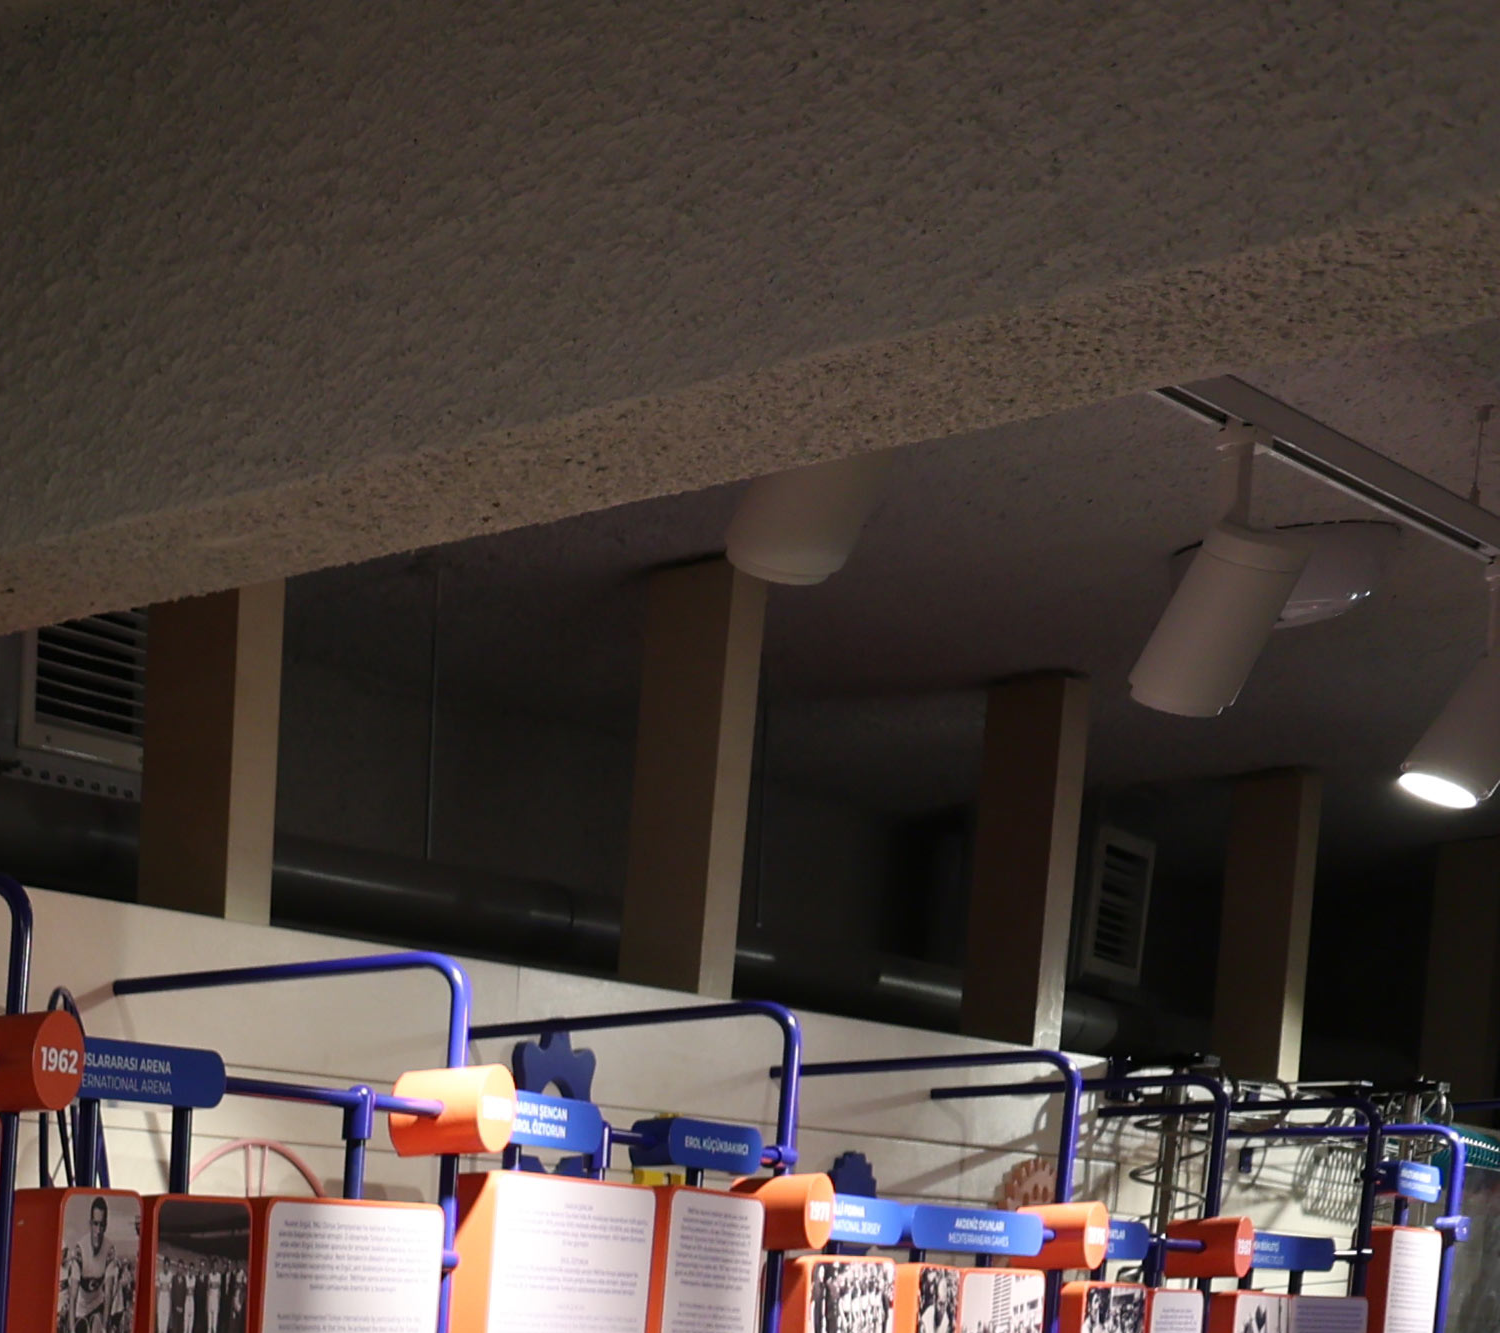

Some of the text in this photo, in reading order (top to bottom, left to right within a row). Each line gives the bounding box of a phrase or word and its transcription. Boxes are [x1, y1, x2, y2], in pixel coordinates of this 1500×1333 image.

[40, 1046, 79, 1075] 1962
[84, 1051, 172, 1075] SLARARASI ARENA
[82, 1073, 172, 1096] ERNATIONAL ARENA
